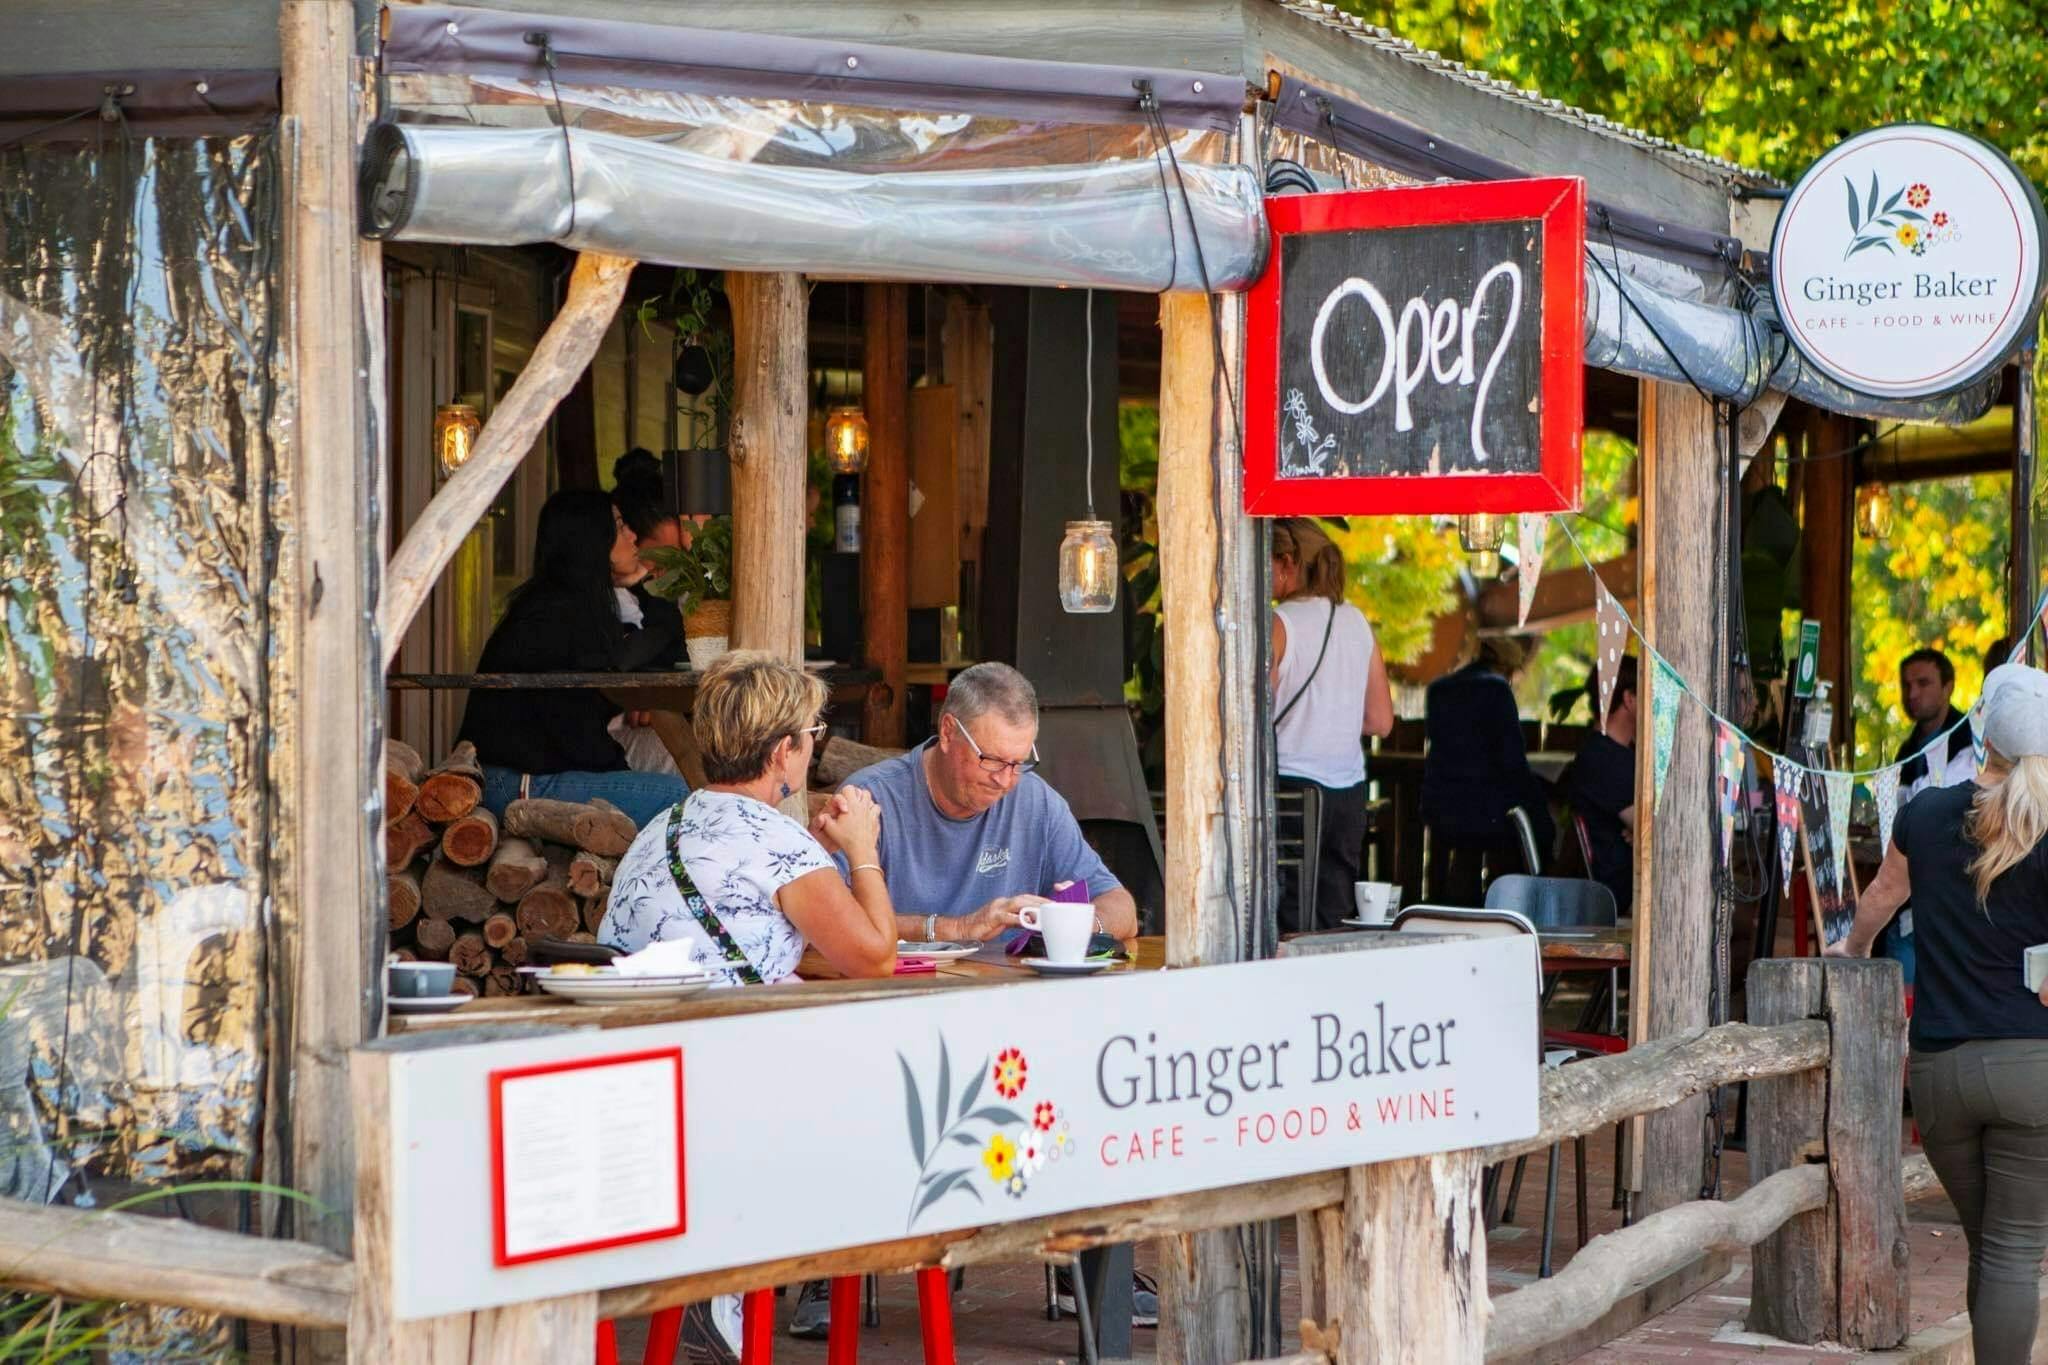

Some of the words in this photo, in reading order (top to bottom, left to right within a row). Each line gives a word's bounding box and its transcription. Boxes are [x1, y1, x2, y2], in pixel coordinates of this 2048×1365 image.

[1803, 276, 1902, 306] Ginger
[1913, 271, 1998, 297] Baker
[1805, 317, 1848, 330] CAFE
[1873, 315, 1923, 328] FOOD
[1933, 314, 1941, 326] &
[1950, 313, 1997, 325] WINE
[1310, 260, 1523, 462] Open
[1097, 1032, 1290, 1117] Ginger
[1311, 1001, 1457, 1083] Baker
[1101, 1124, 1184, 1167] CAFE
[1237, 1107, 1329, 1147] FOOD
[1347, 1102, 1362, 1130] &
[1376, 1088, 1456, 1125] WINE
